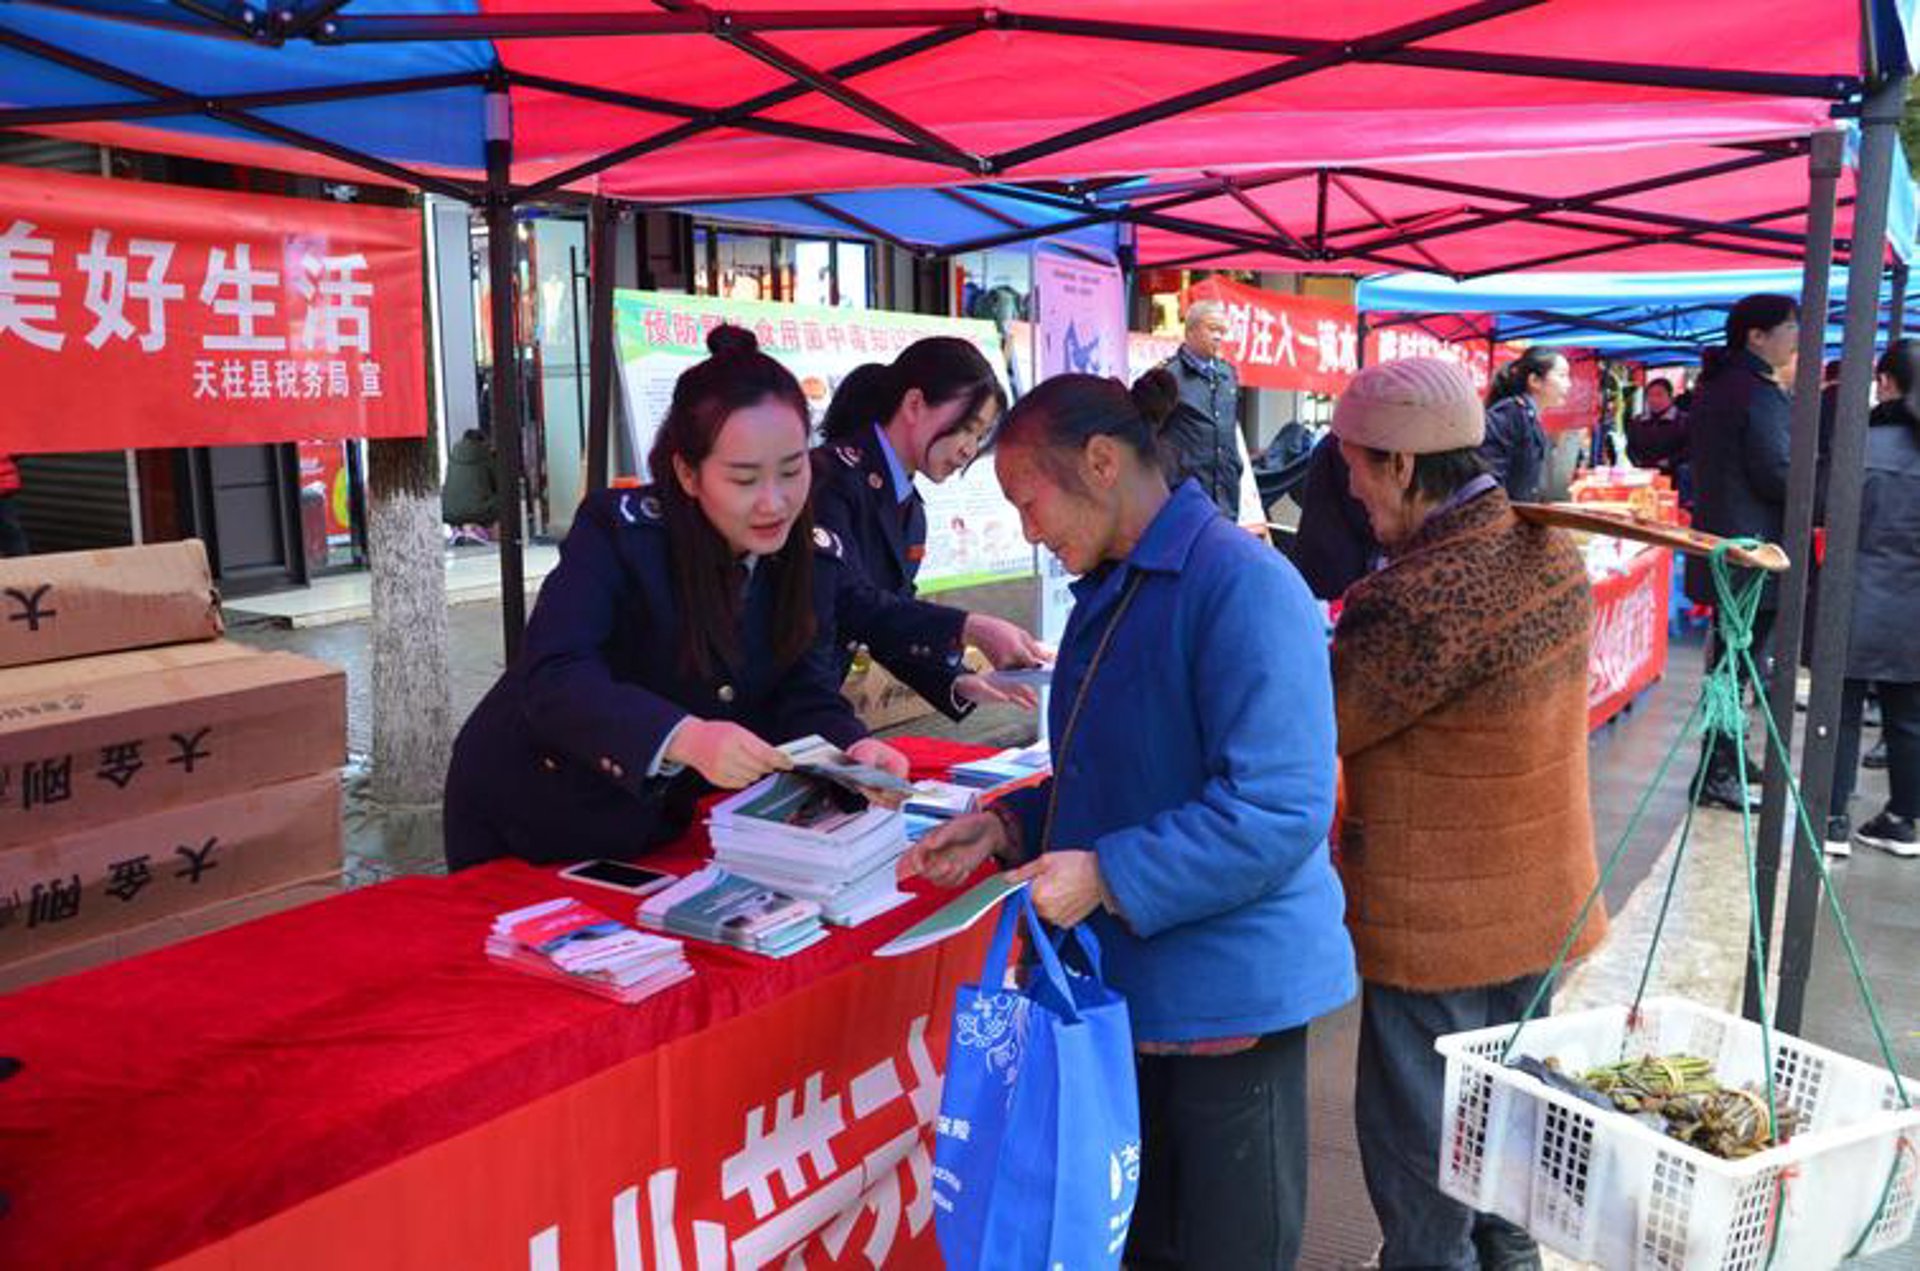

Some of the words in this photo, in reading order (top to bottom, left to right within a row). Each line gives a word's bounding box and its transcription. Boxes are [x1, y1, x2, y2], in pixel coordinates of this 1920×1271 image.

[0, 220, 375, 354] 美好生活
[193, 359, 350, 400] 天柱县税务局
[359, 360, 383, 398] 宣
[0, 726, 212, 812] 大金刚
[0, 837, 218, 929] 大金刚
